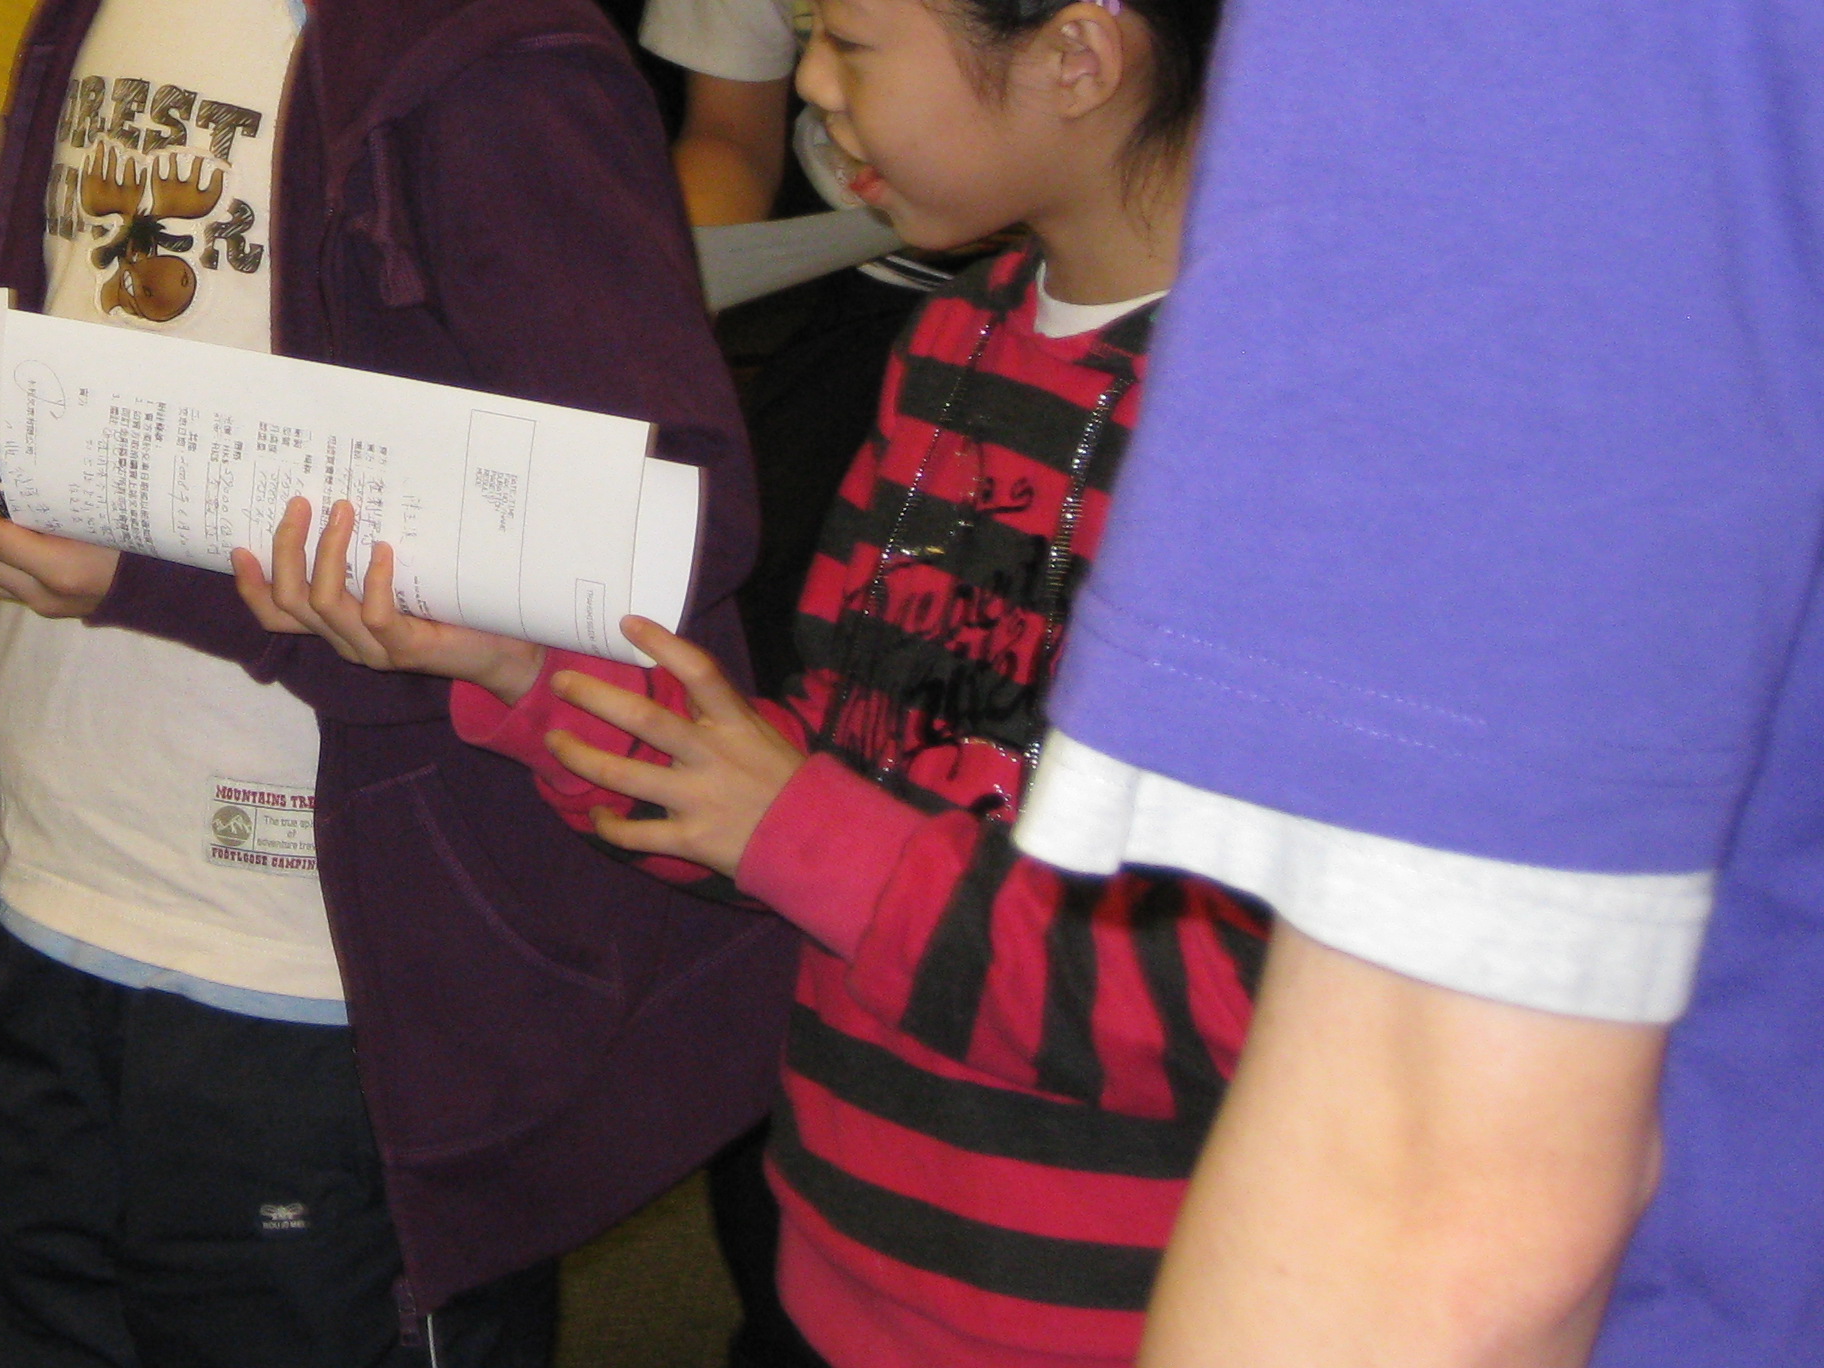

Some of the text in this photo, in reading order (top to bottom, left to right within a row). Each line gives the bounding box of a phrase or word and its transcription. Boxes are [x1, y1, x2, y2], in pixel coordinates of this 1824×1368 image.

[215, 784, 287, 808] MOUNTAINS
[264, 815, 279, 826] The
[286, 828, 297, 838] of
[211, 847, 317, 872] FOOTLOOSE CAMPIN
